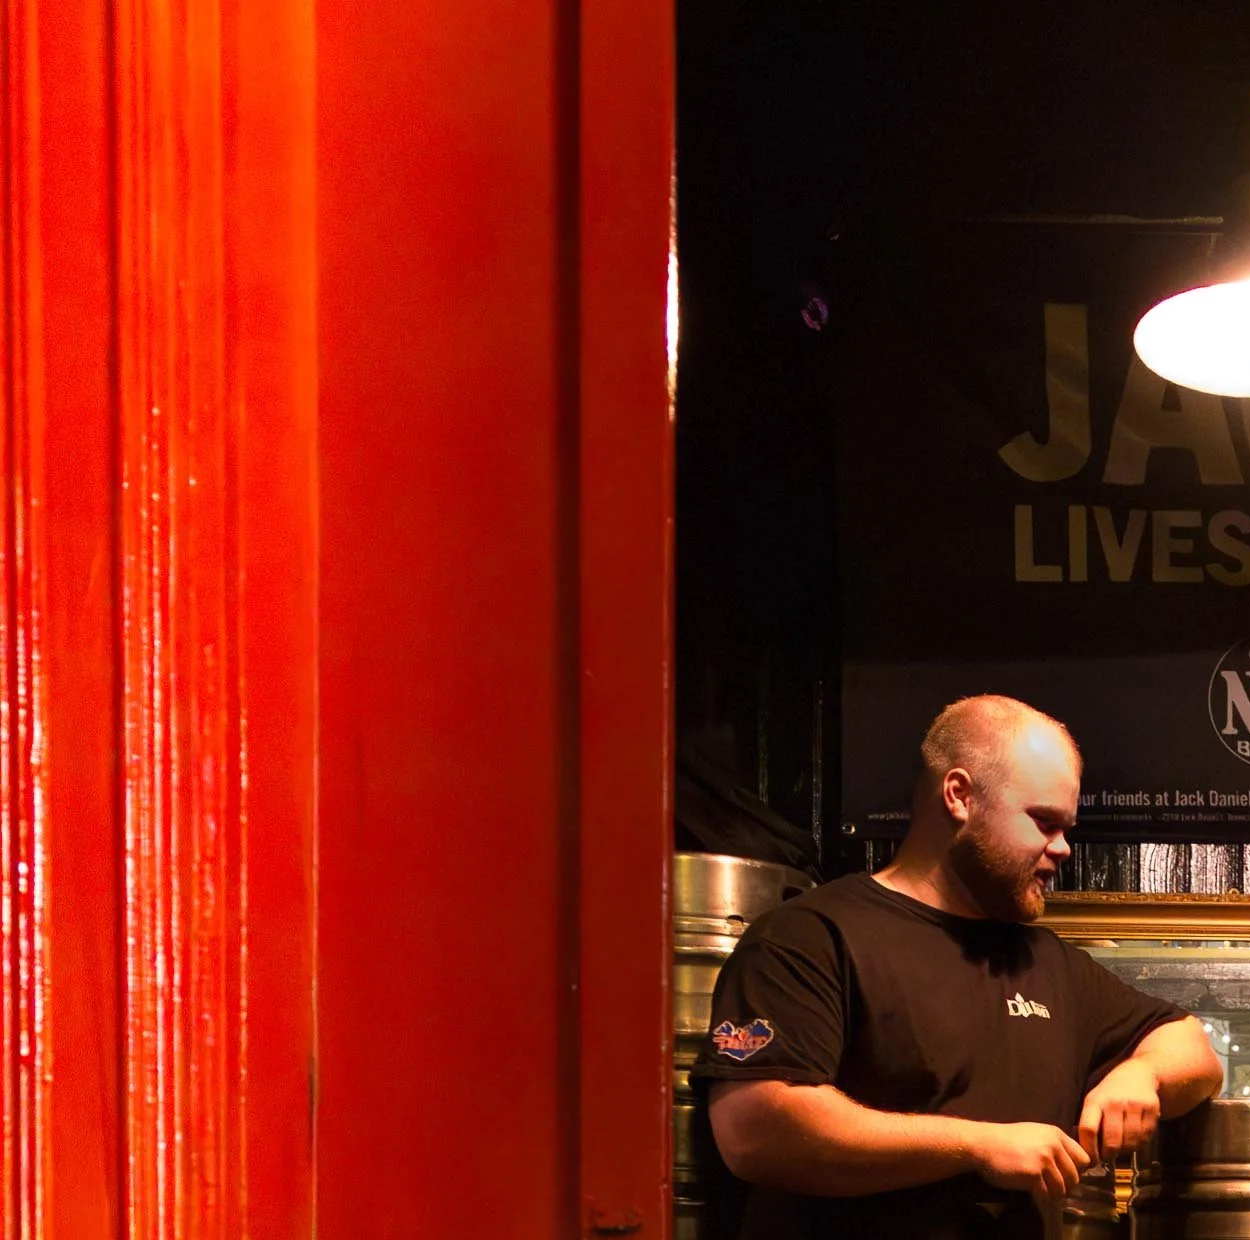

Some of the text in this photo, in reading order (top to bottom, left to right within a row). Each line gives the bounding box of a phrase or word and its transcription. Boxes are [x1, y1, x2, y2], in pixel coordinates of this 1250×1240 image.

[1102, 789, 1151, 807] friends
[1155, 791, 1170, 807] at
[1174, 789, 1205, 807] Jack
